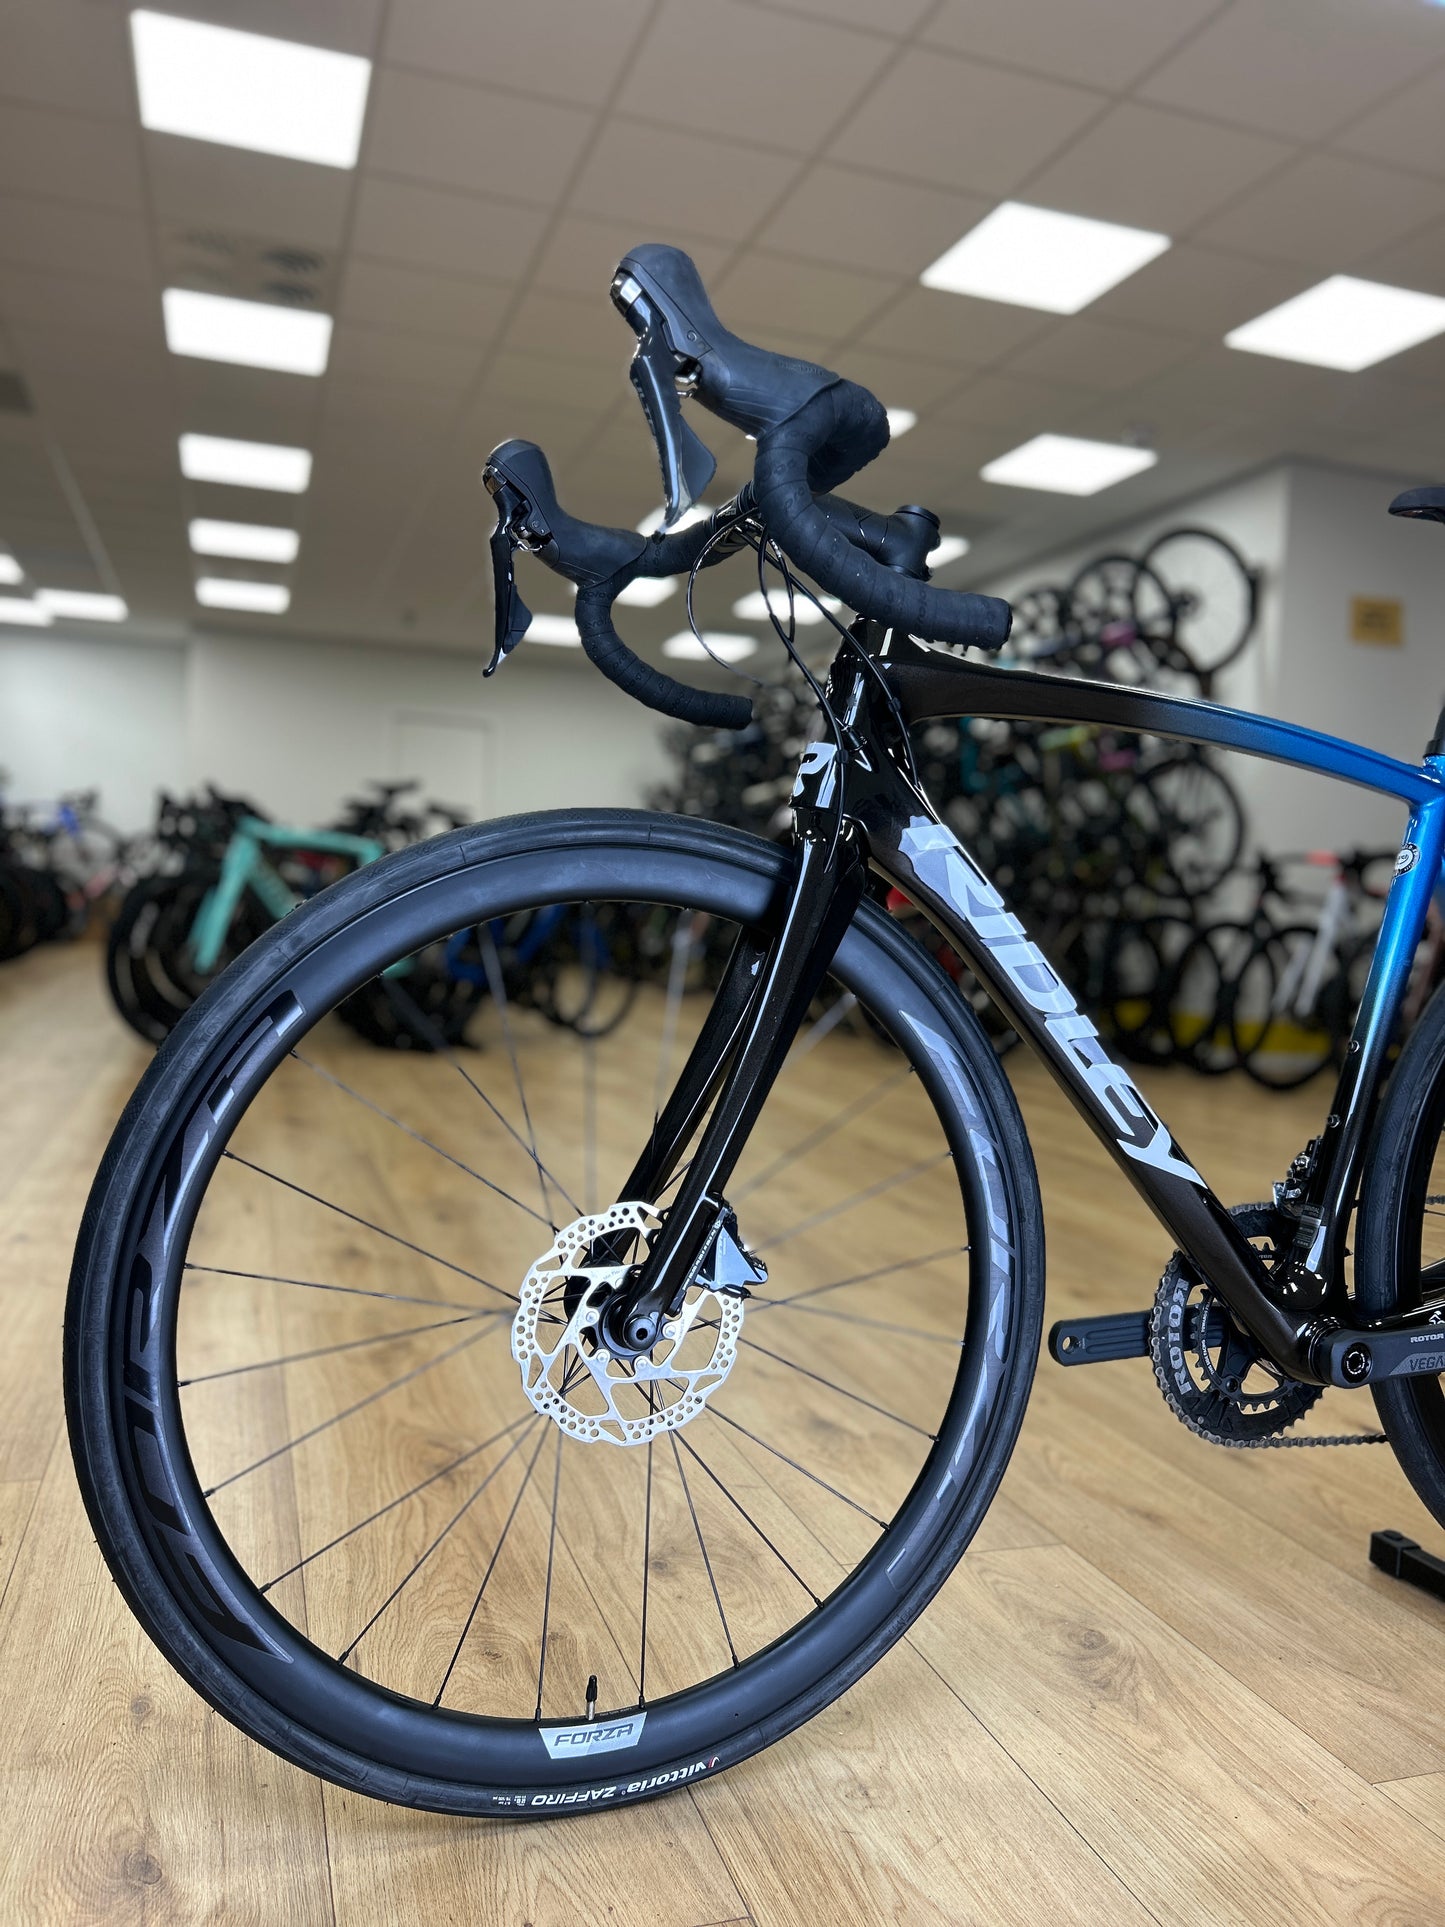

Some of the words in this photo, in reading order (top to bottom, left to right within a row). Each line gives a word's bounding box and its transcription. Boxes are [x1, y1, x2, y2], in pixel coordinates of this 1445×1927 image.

[1168, 1278, 1192, 1395] ROTOR
[1410, 1333, 1444, 1343] ROTOR
[554, 1723, 634, 1747] FORZA
[627, 1760, 706, 1793] vittoria
[531, 1786, 617, 1806] ZAFFIRO
